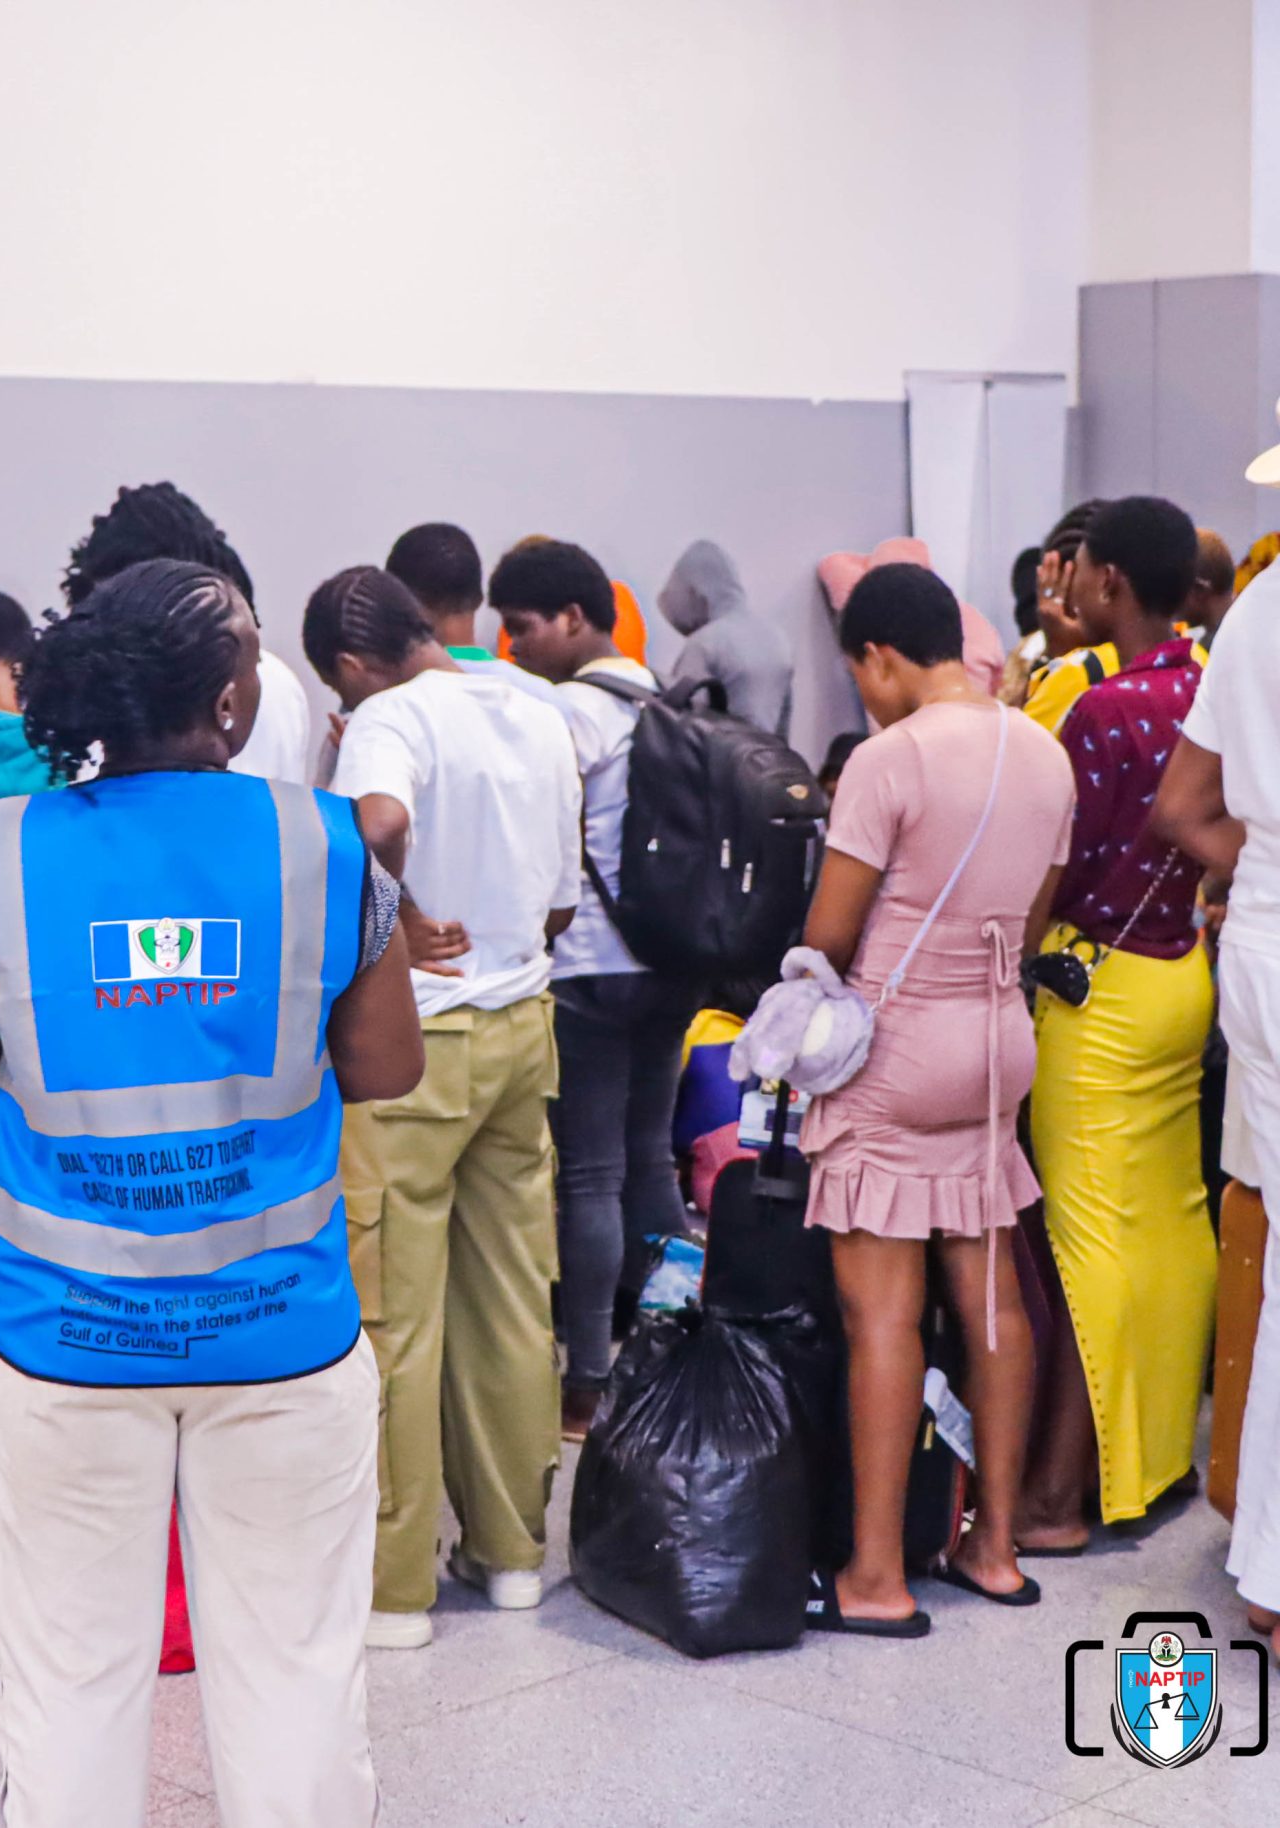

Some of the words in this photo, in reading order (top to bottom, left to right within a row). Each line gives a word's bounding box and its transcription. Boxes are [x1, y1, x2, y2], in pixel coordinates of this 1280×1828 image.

[95, 982, 237, 1009] NAPTIP
[56, 1151, 89, 1174] DIAL
[127, 1152, 147, 1178] OR
[149, 1147, 184, 1176] CALL
[186, 1143, 213, 1170] 627
[217, 1141, 231, 1166] TO
[116, 1186, 129, 1210] OF
[132, 1183, 184, 1212] HUMAN
[124, 1297, 150, 1315] the
[154, 1296, 190, 1316] fight
[194, 1288, 254, 1310] against
[259, 1273, 301, 1298] human
[144, 1320, 159, 1334] in
[164, 1318, 190, 1333] the
[195, 1312, 241, 1331] states
[246, 1307, 261, 1322] of
[264, 1300, 288, 1316] the
[59, 1321, 92, 1341] Gulf
[95, 1331, 111, 1346] of
[116, 1332, 179, 1352] Guinea
